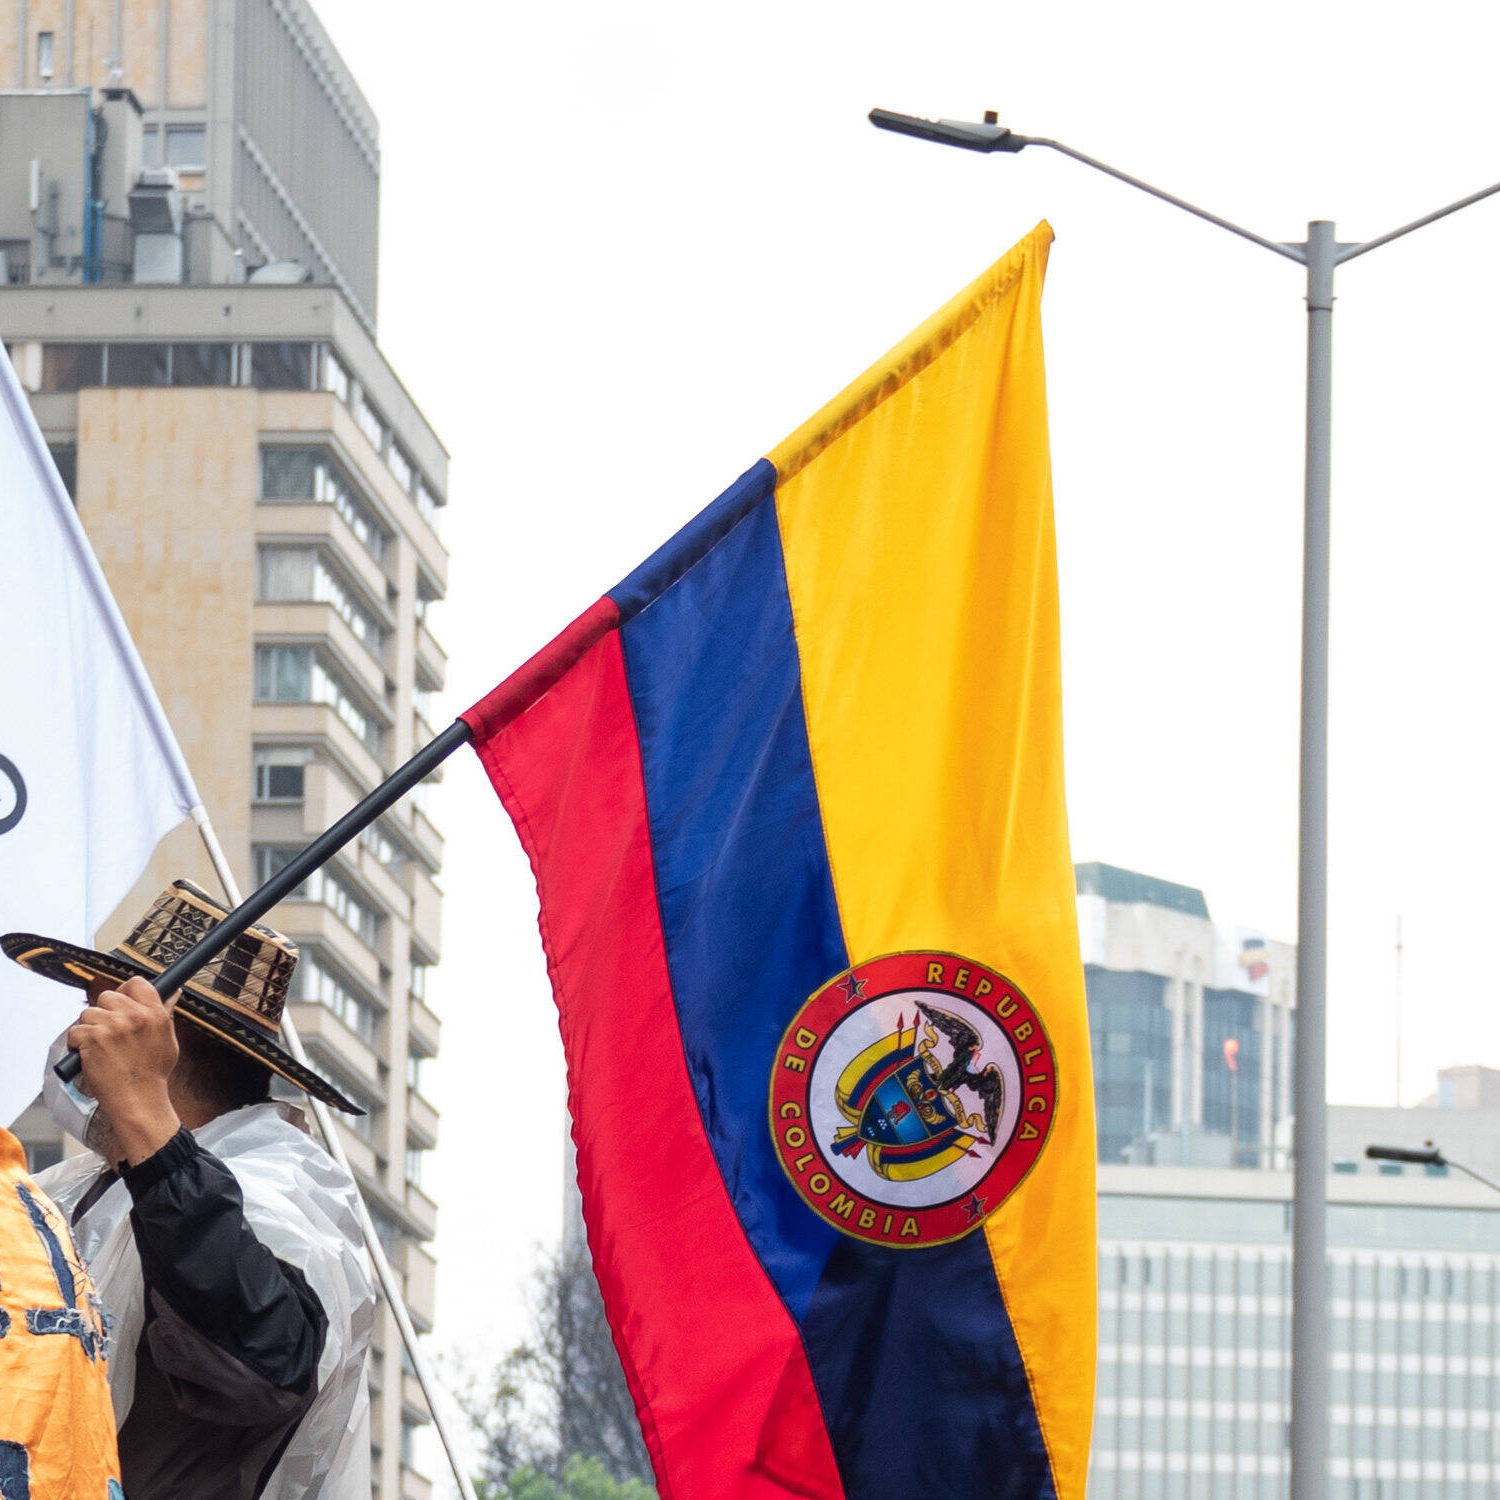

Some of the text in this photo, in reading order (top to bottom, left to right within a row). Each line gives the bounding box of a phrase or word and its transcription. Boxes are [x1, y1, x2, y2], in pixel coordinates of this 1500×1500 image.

[780, 1026, 920, 1237] DE COLOMBIA
[926, 961, 1046, 1142] REPUBLICA
